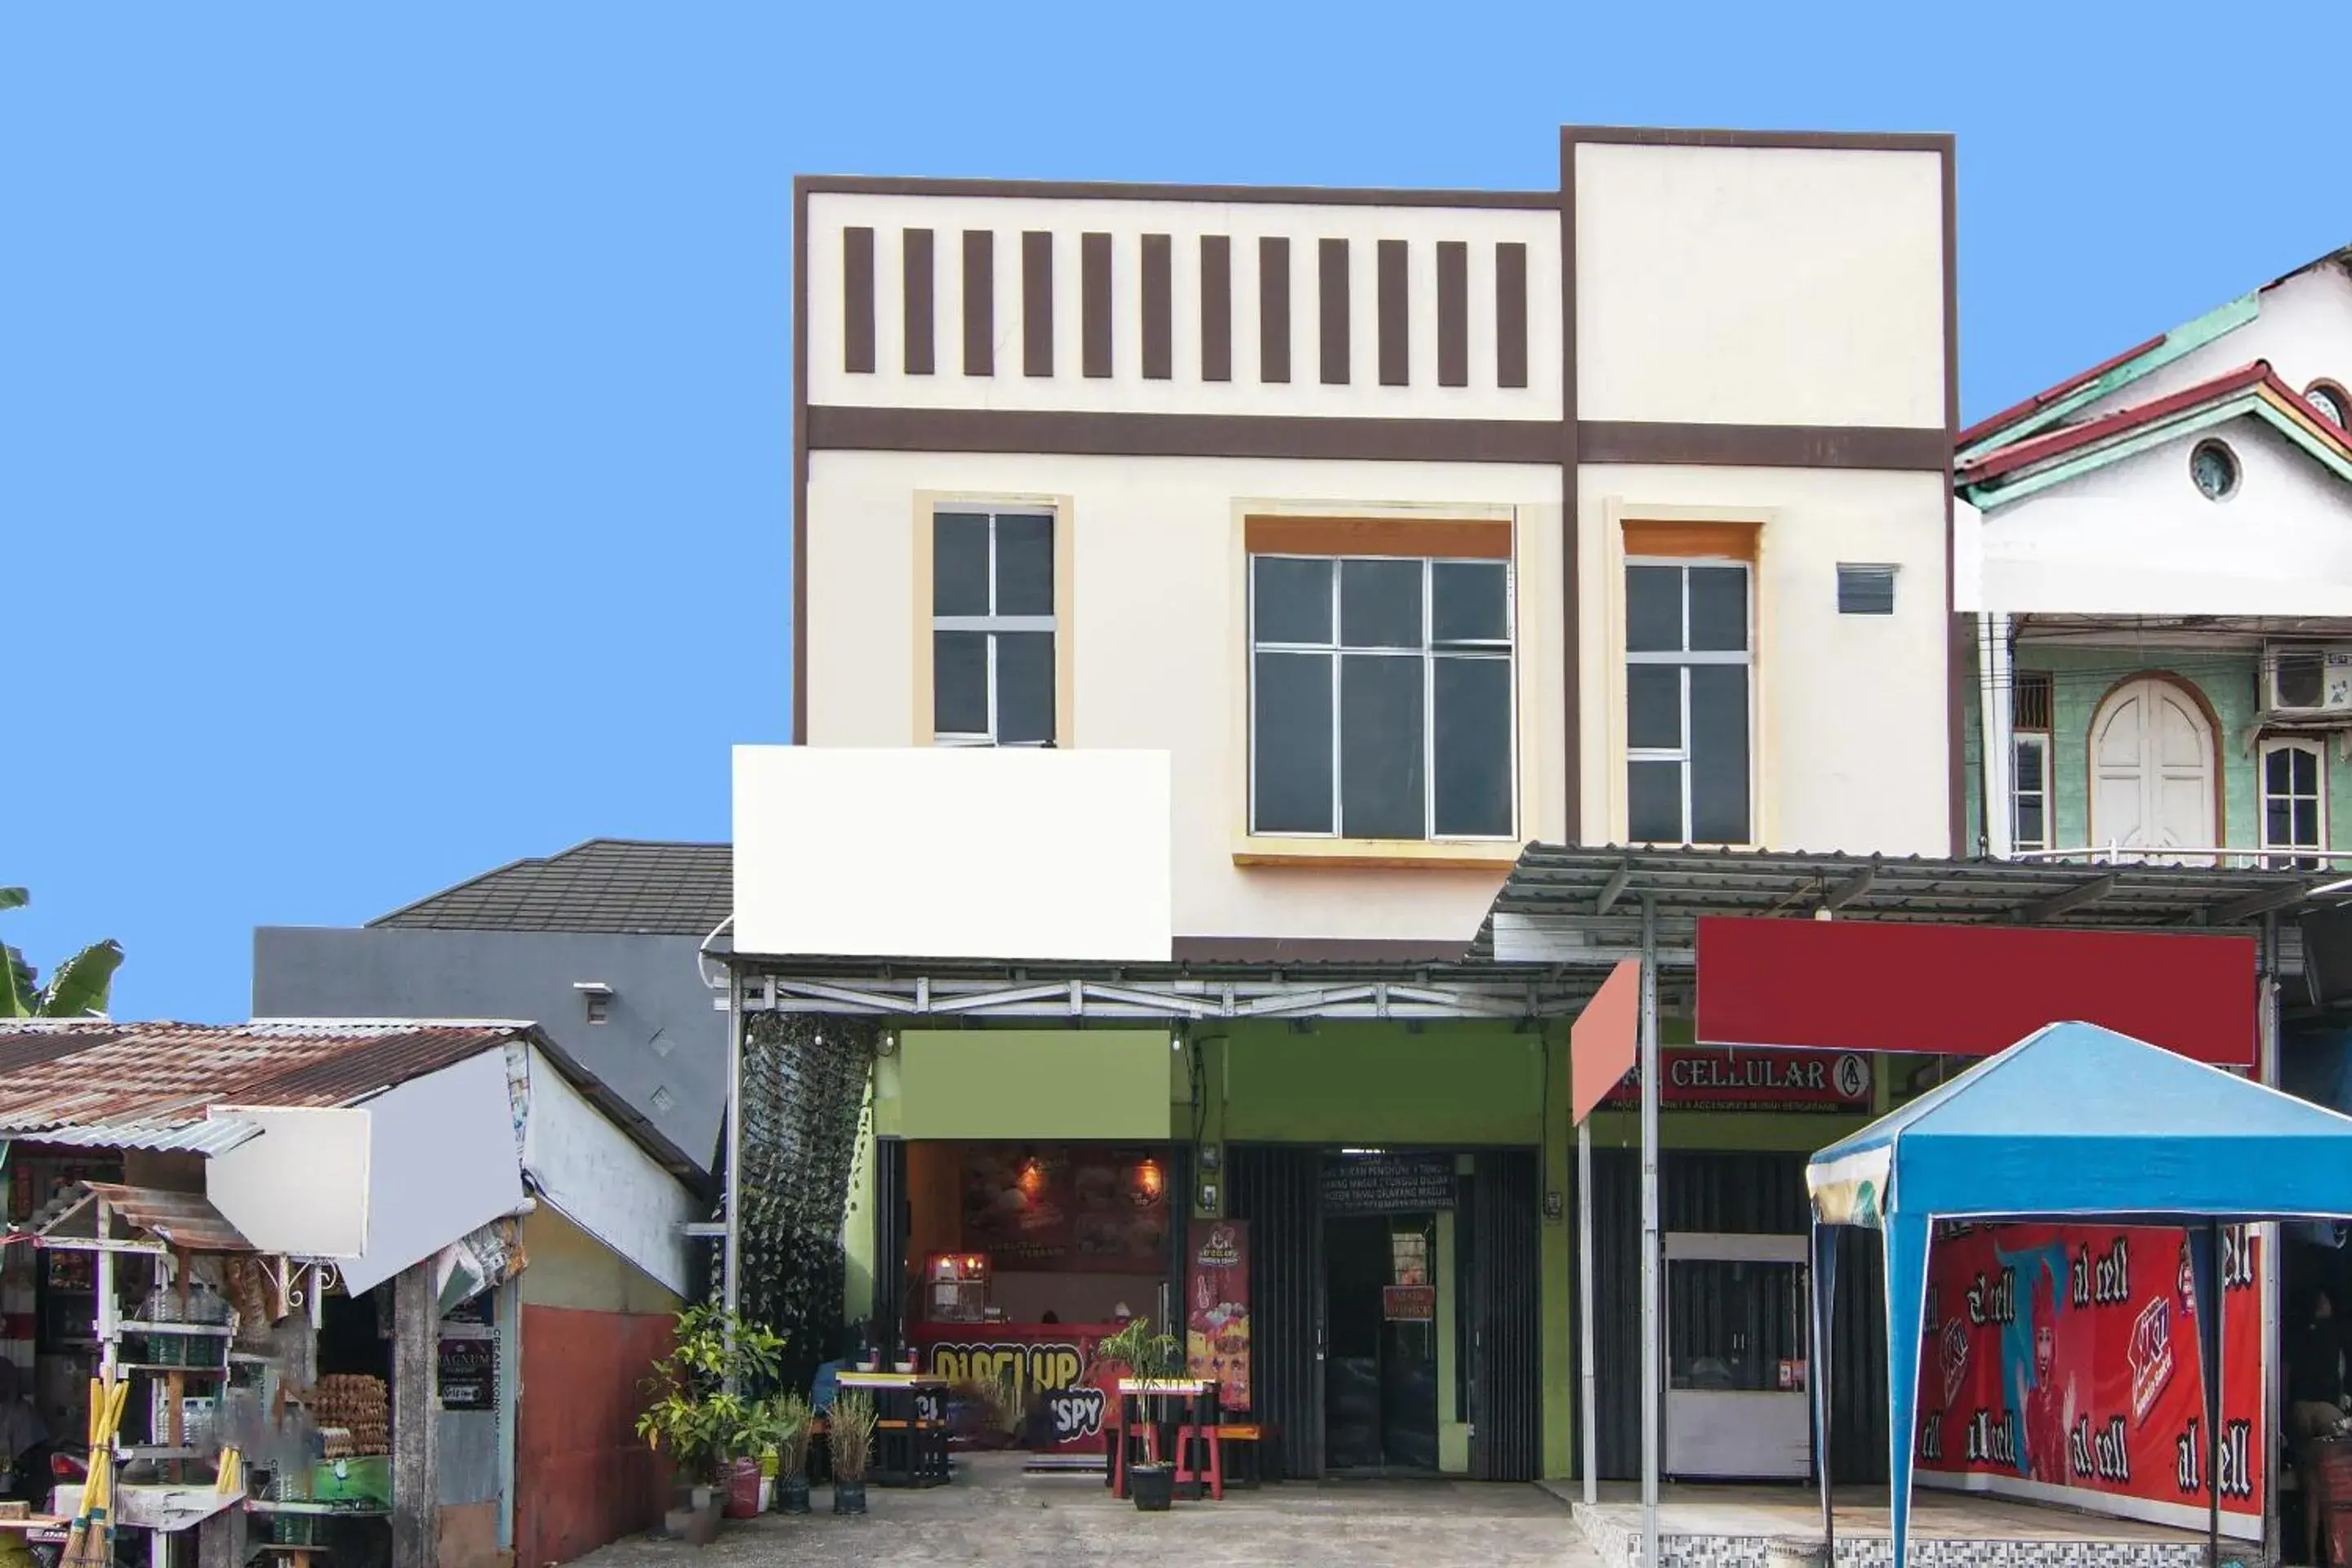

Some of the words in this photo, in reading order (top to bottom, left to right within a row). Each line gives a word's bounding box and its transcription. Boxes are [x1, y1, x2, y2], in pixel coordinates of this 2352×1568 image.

[1671, 1059, 1826, 1089] CELLULAR
[2095, 1239, 2128, 1303] cell
[2095, 1418, 2129, 1480] cell
[2177, 1423, 2199, 1490] al
